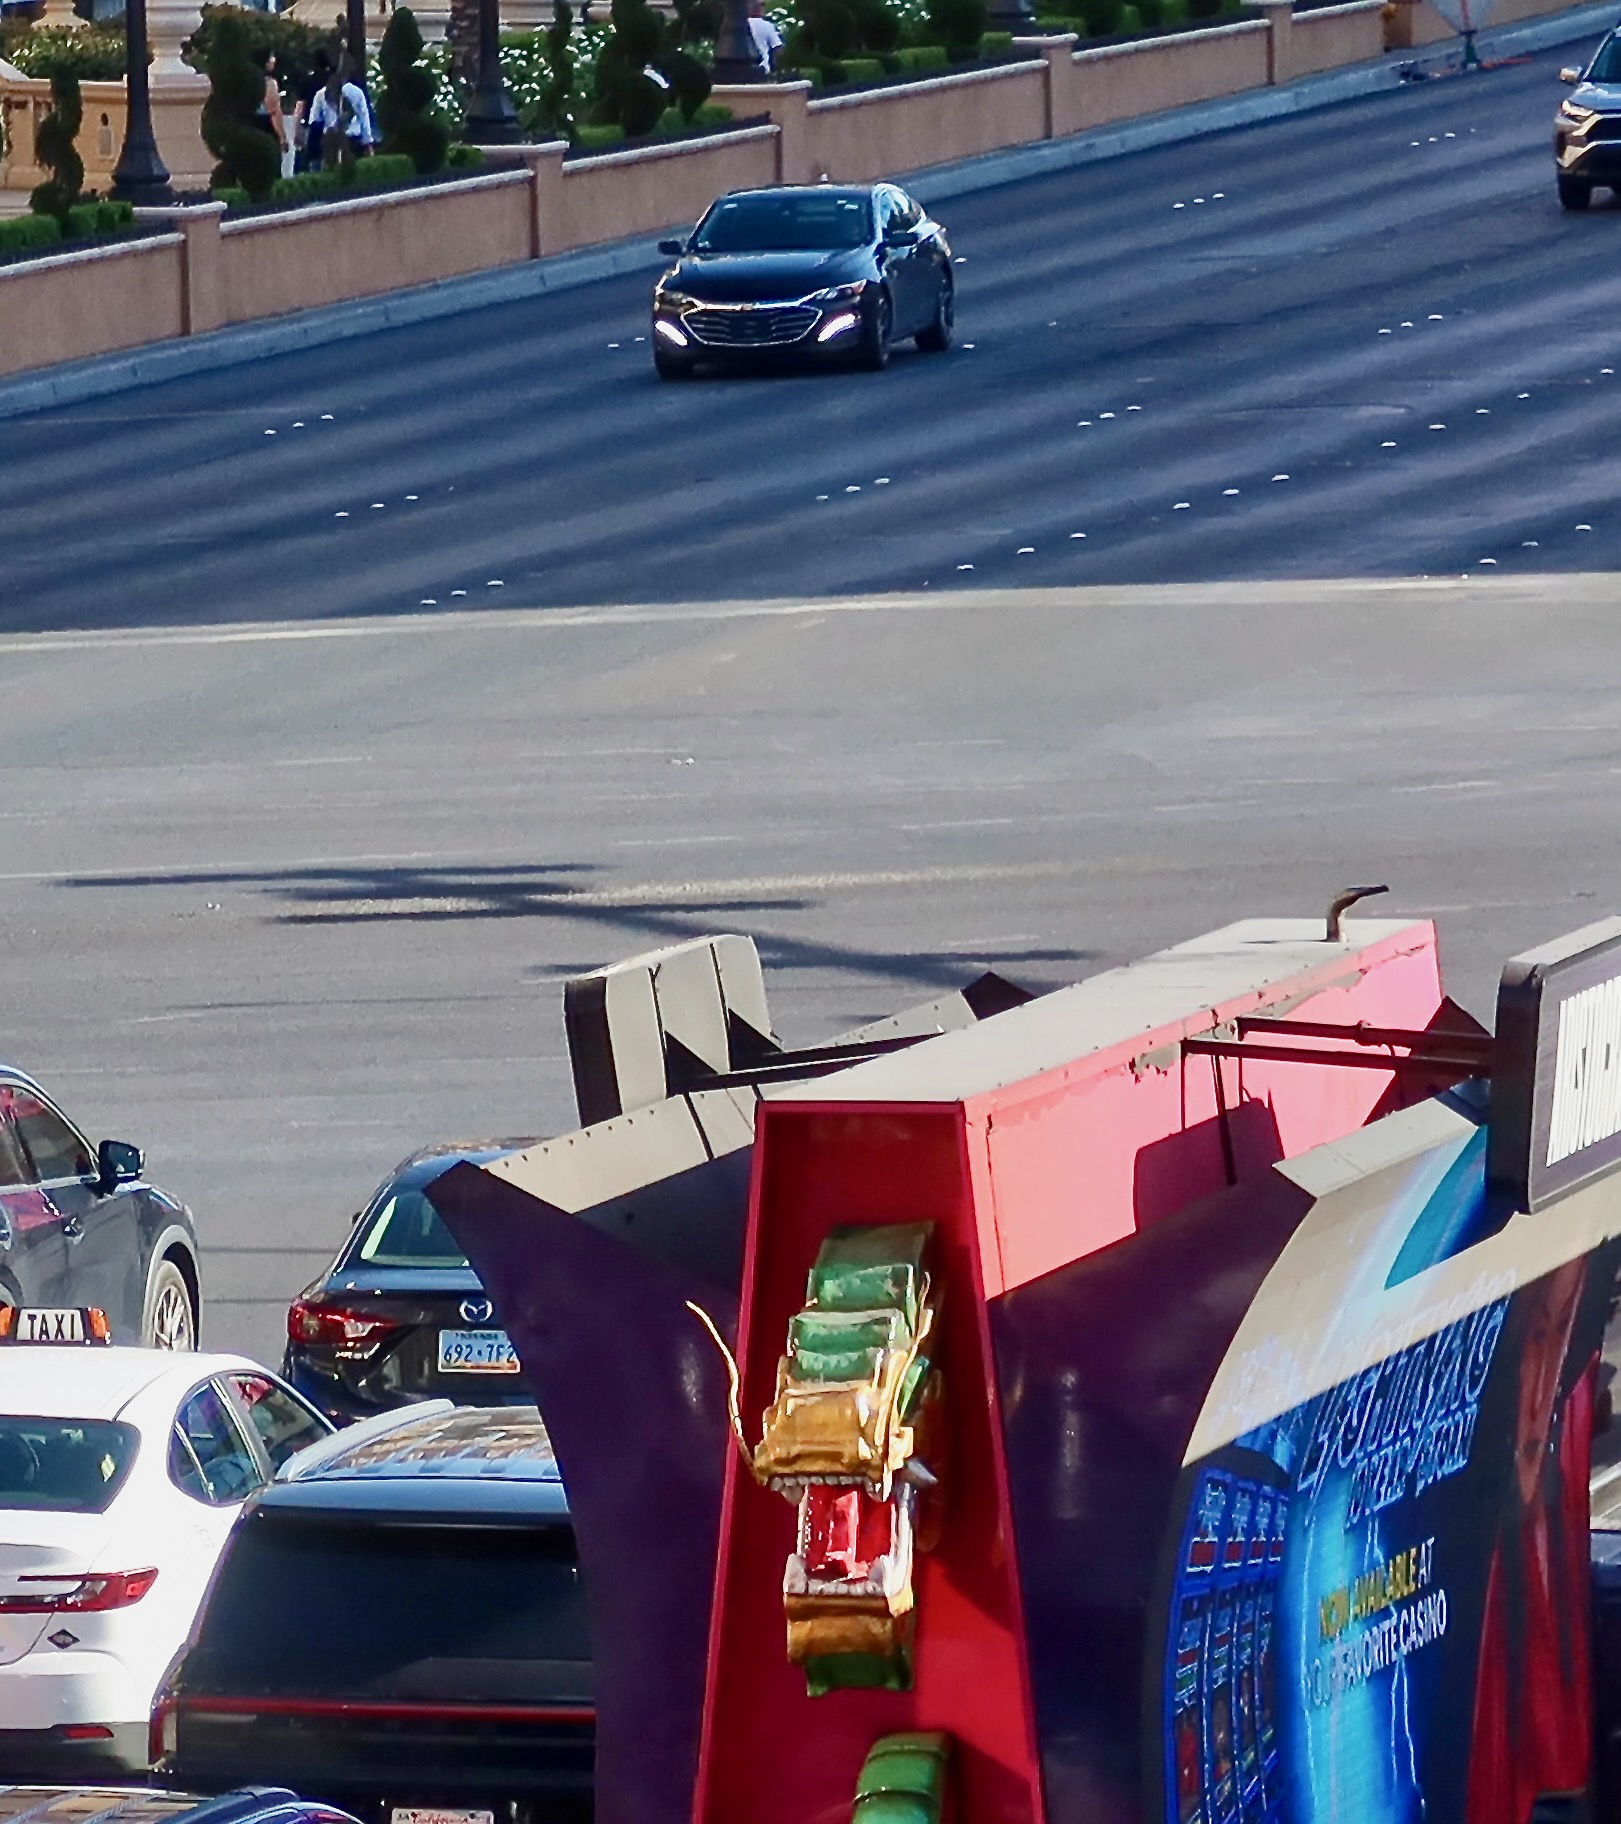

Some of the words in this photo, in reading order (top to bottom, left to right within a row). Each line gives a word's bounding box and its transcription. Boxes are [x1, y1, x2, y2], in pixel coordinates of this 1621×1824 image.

[27, 1313, 75, 1340] TAXI
[1417, 1537, 1436, 1589] AT
[1399, 1588, 1447, 1657] CASINO
